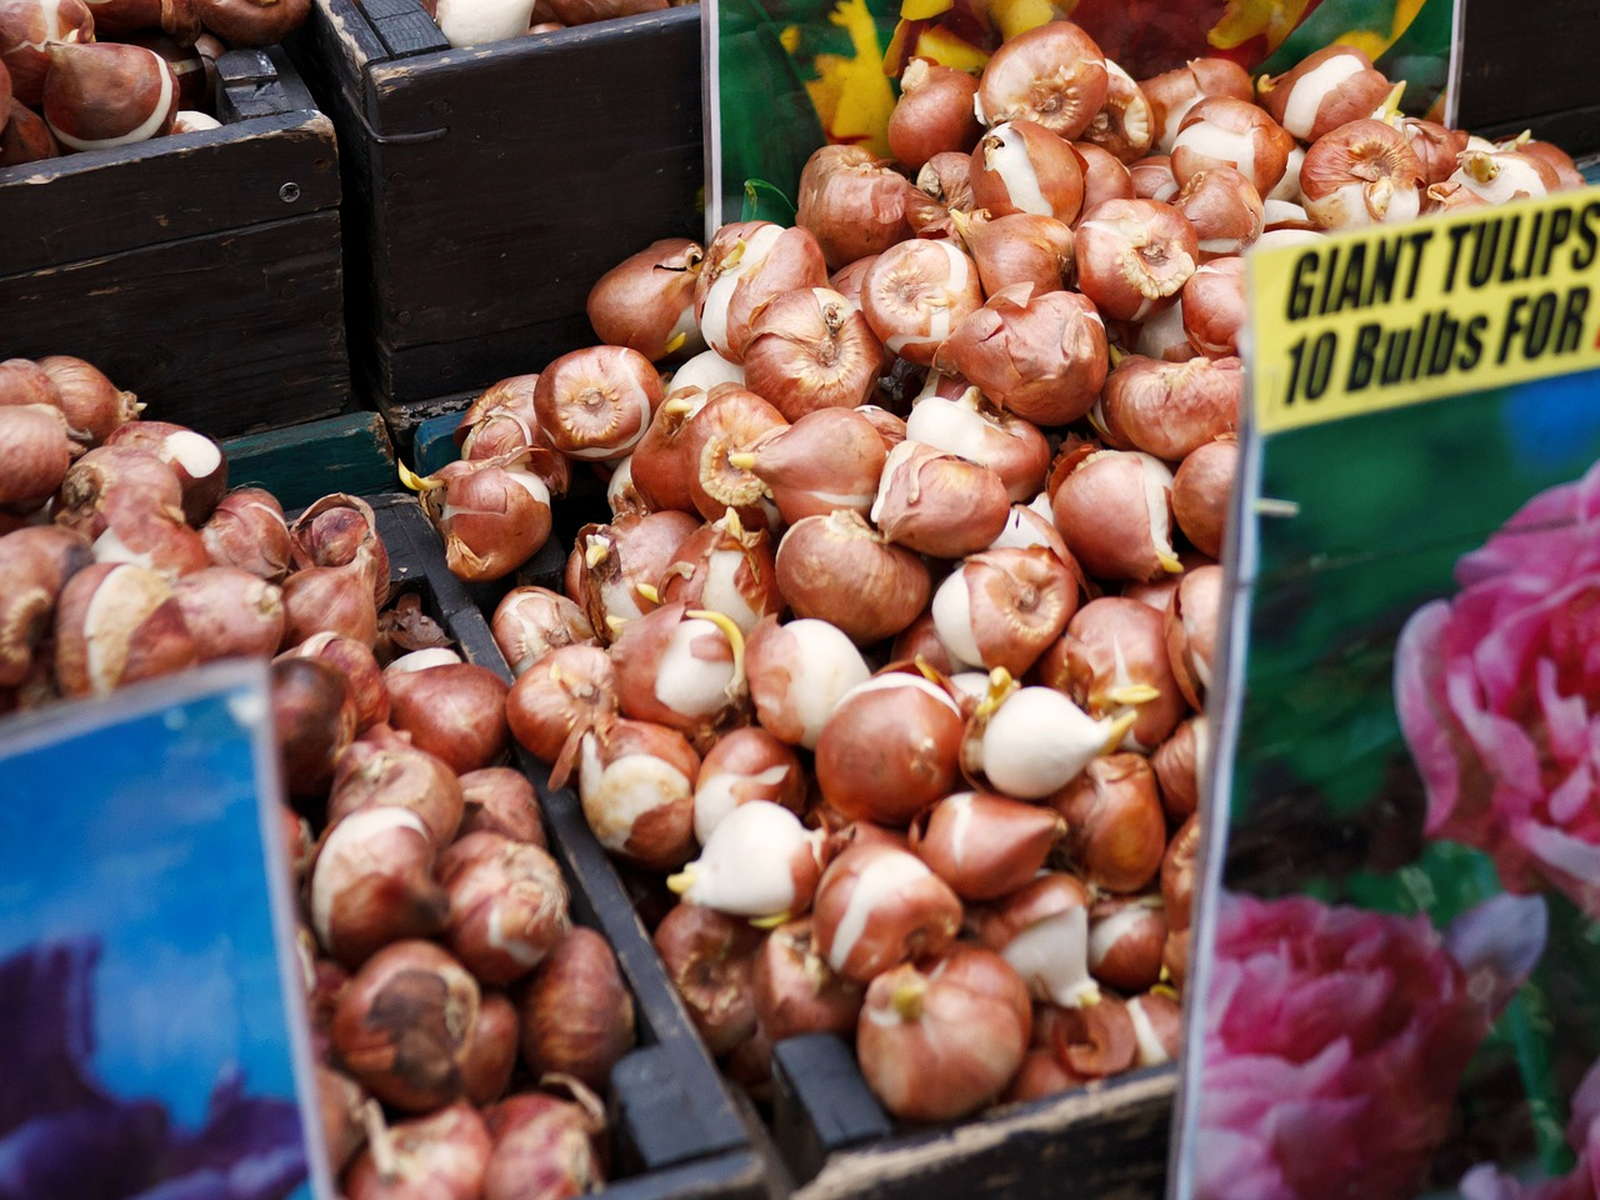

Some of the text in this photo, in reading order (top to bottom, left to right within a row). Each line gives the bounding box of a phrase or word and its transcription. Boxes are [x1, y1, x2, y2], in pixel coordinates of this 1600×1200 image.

[1285, 201, 1600, 322] GIANT TULIPS
[1284, 286, 1591, 407] 10 Bulbs FOR
